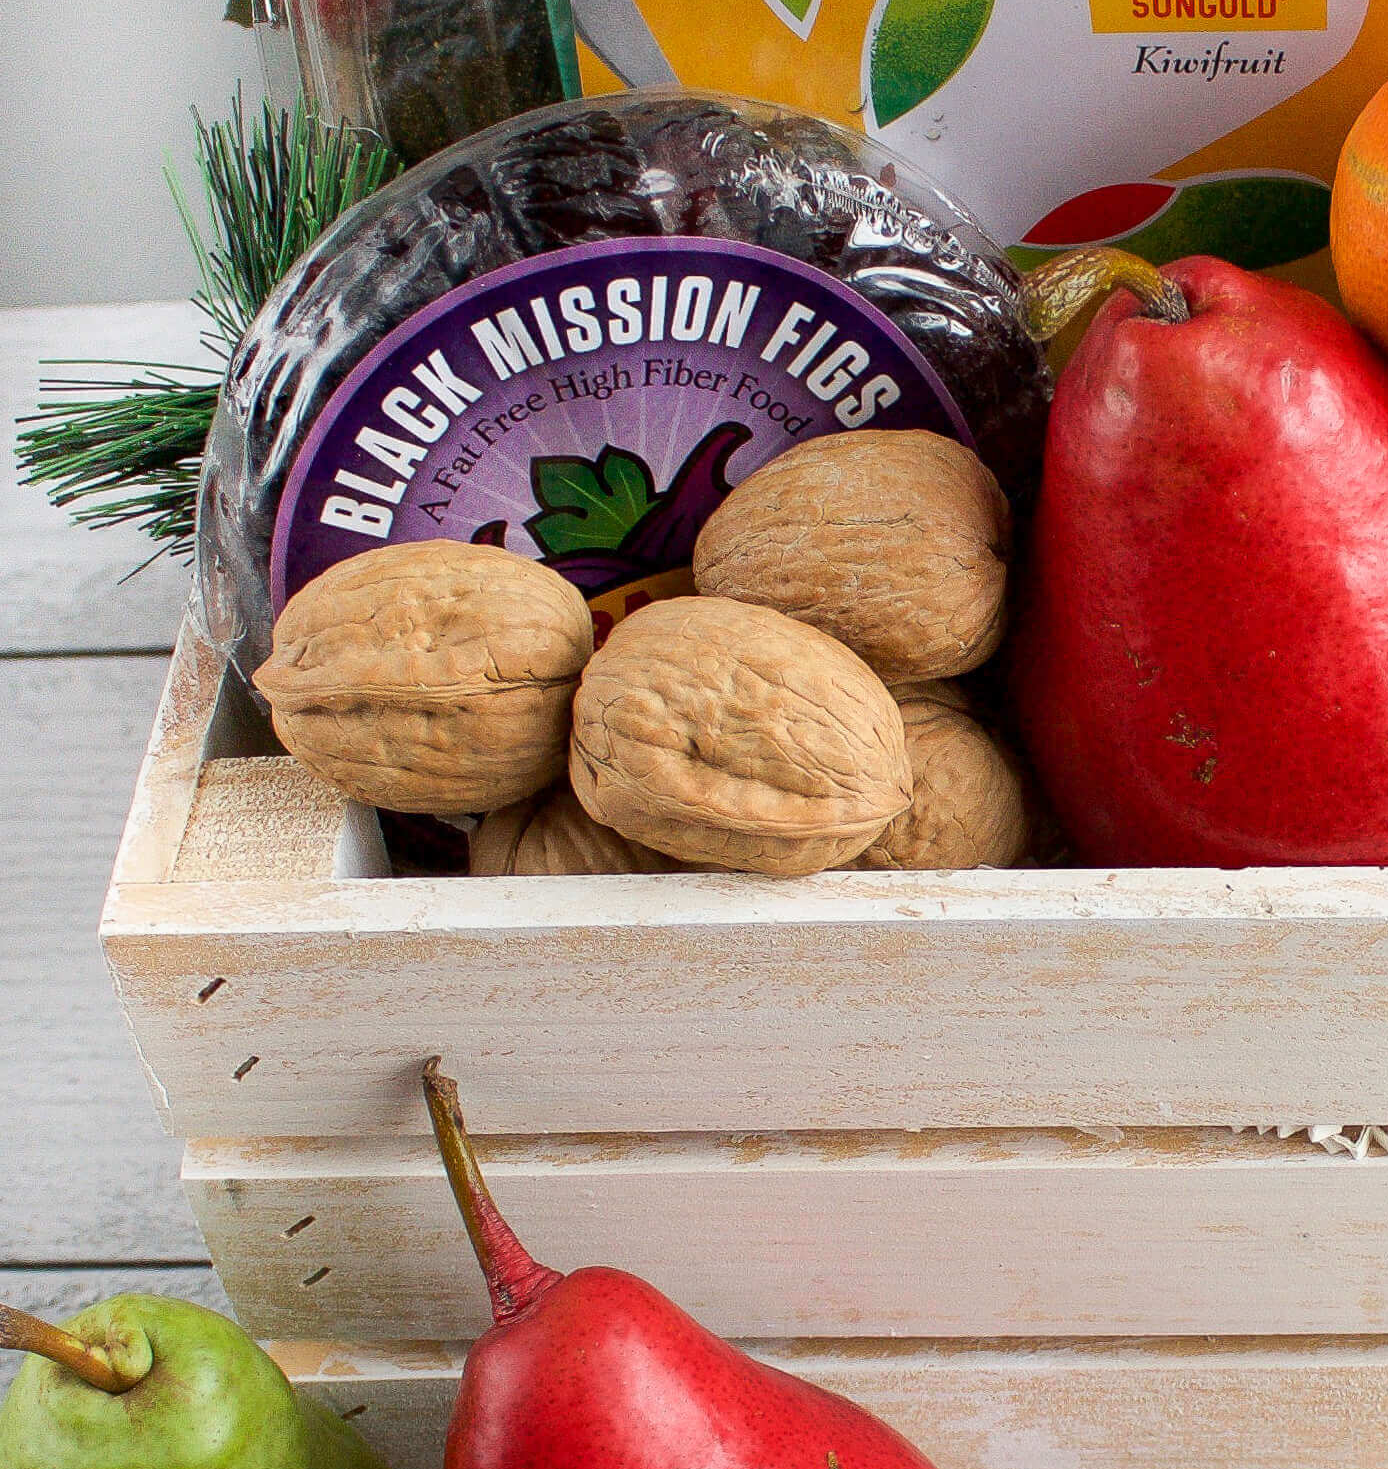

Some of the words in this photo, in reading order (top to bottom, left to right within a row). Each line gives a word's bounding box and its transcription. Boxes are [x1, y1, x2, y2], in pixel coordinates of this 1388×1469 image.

[1131, 40, 1287, 82] Kiwifruit
[319, 348, 485, 540] BLACK
[469, 274, 762, 382] MISSION
[759, 300, 902, 430] FIGS
[418, 496, 450, 525] A
[434, 442, 483, 494] Fat
[472, 390, 548, 447] Free
[550, 363, 633, 402] High
[643, 357, 730, 395] Fiber
[732, 373, 815, 437] Food
